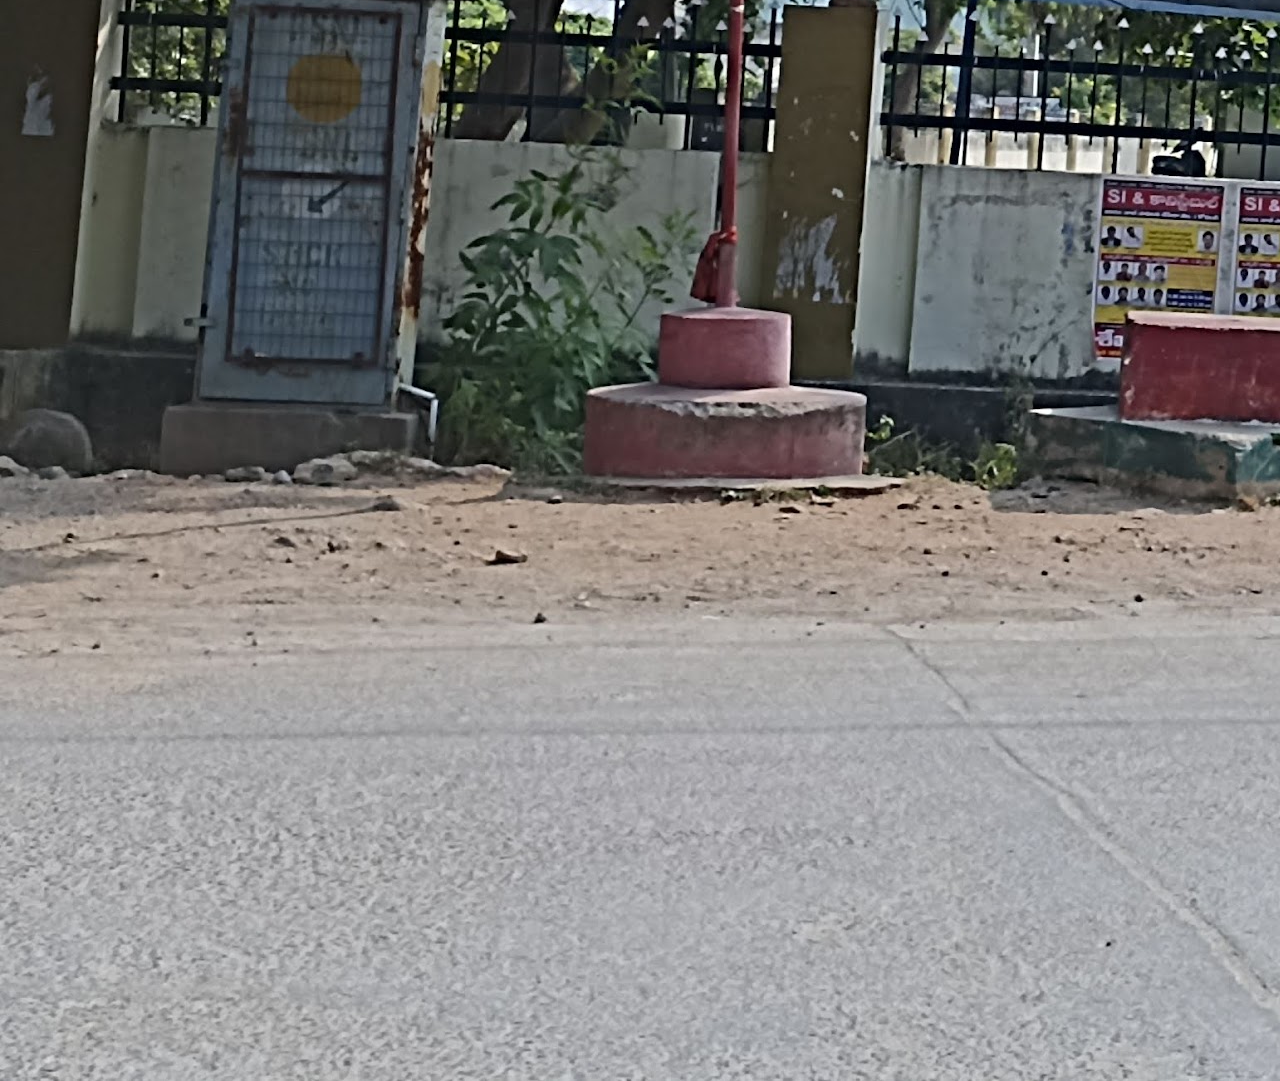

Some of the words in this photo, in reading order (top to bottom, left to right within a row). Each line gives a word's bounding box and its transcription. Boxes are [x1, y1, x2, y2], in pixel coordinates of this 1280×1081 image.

[1107, 189, 1127, 204] SI
[1132, 192, 1145, 205] &
[1244, 197, 1263, 211] SI
[1268, 199, 1280, 212] &
